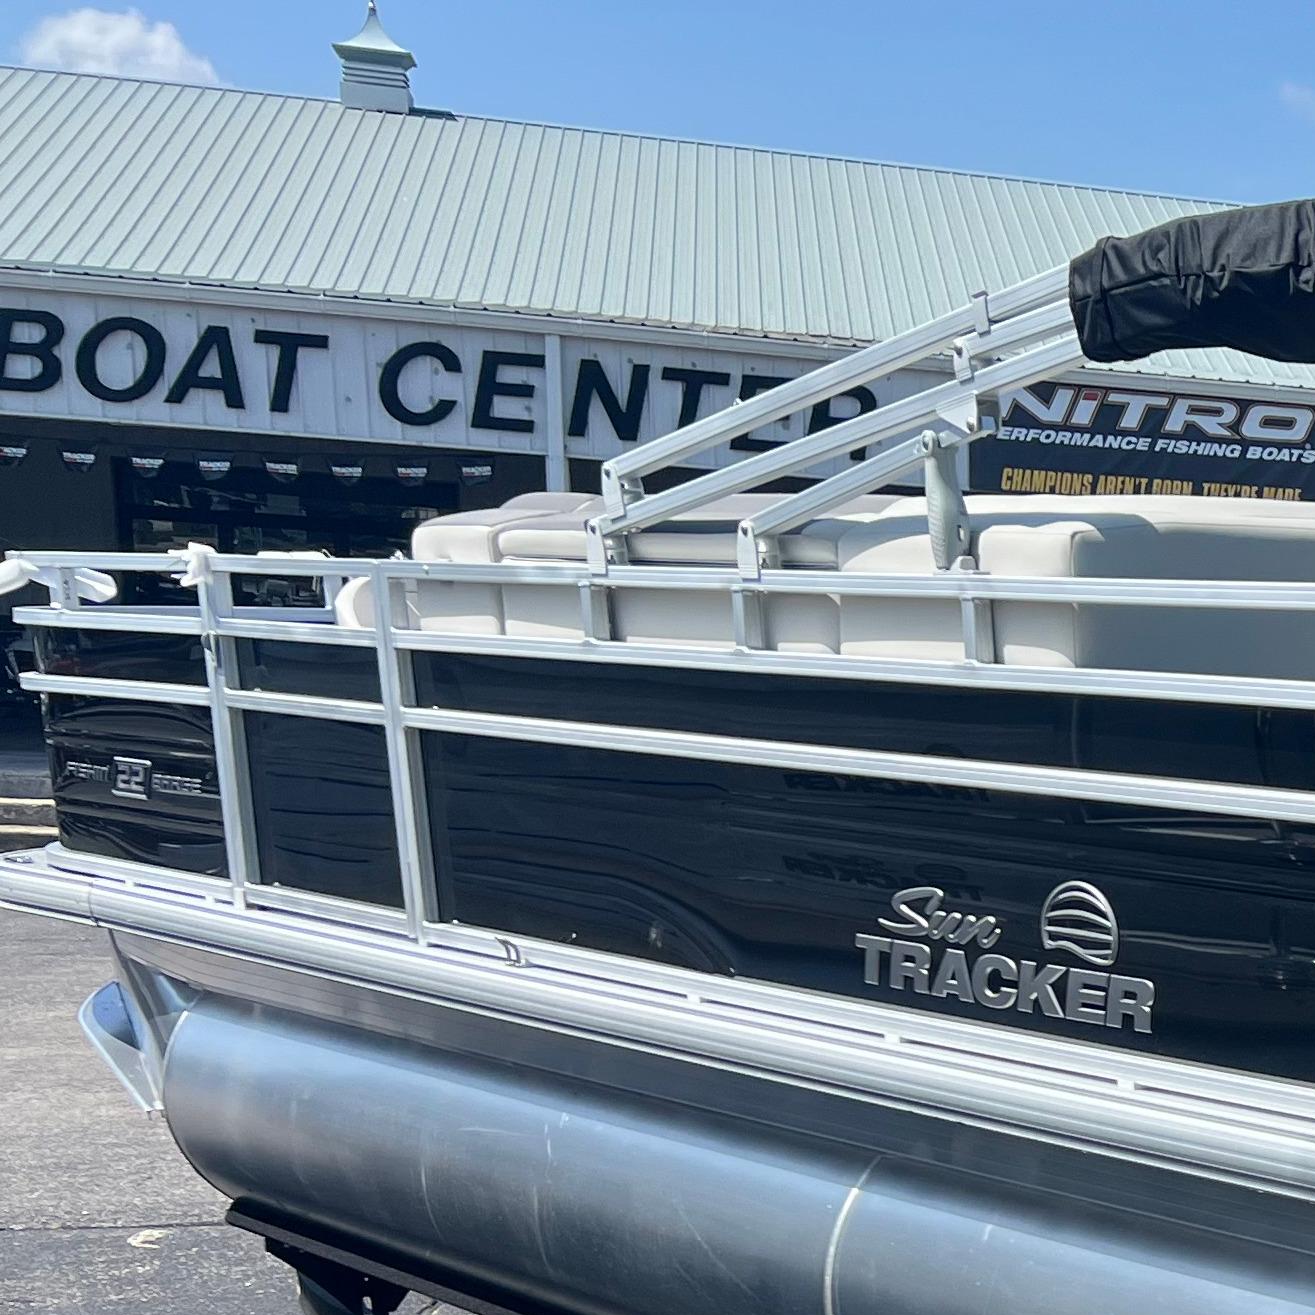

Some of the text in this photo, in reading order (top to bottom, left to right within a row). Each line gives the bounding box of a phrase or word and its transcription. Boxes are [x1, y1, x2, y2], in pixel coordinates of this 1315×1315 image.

[0, 307, 329, 412] BOAT
[1154, 439, 1242, 459] FISHING
[1001, 467, 1093, 495] CHAMPIONS
[1096, 474, 1149, 495] AREN'T
[115, 763, 146, 792] 22
[877, 886, 1001, 948] Sun
[855, 933, 1156, 1034] TRACKER
